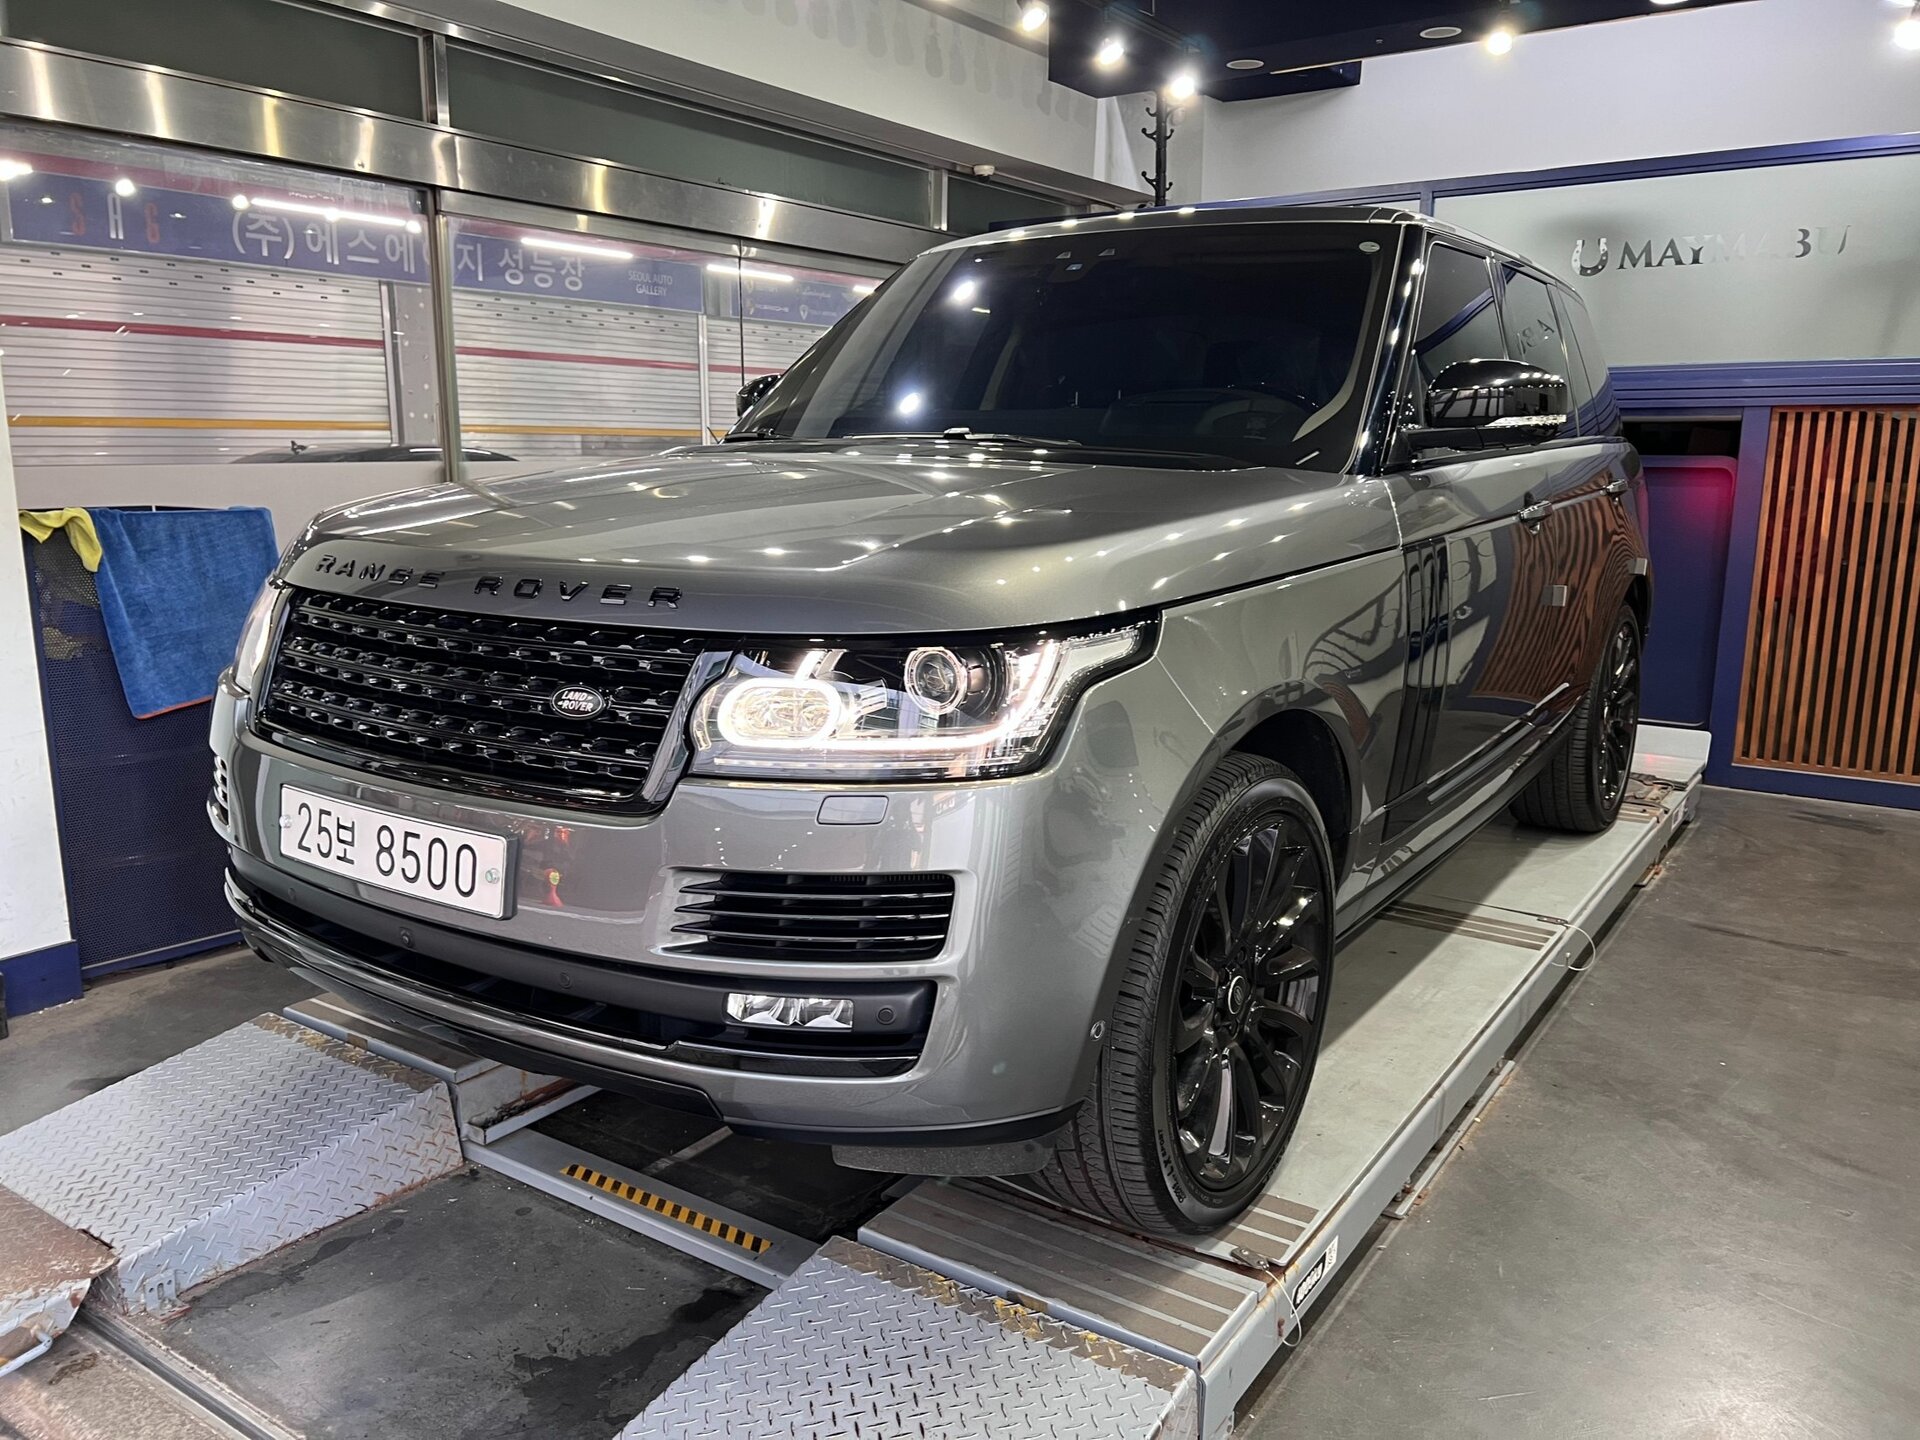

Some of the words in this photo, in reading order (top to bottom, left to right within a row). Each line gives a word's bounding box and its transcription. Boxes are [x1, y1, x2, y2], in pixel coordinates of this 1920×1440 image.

[498, 248, 585, 292] 성능장
[628, 270, 651, 283] SEOUL
[652, 274, 673, 285] AUTO
[636, 283, 667, 296] GALLERY
[315, 553, 445, 589] RANGE
[473, 575, 683, 610] ROVER
[561, 690, 588, 701] LAND
[561, 699, 594, 712] ROVER
[297, 802, 355, 866] 25보
[375, 824, 478, 898] 8500
